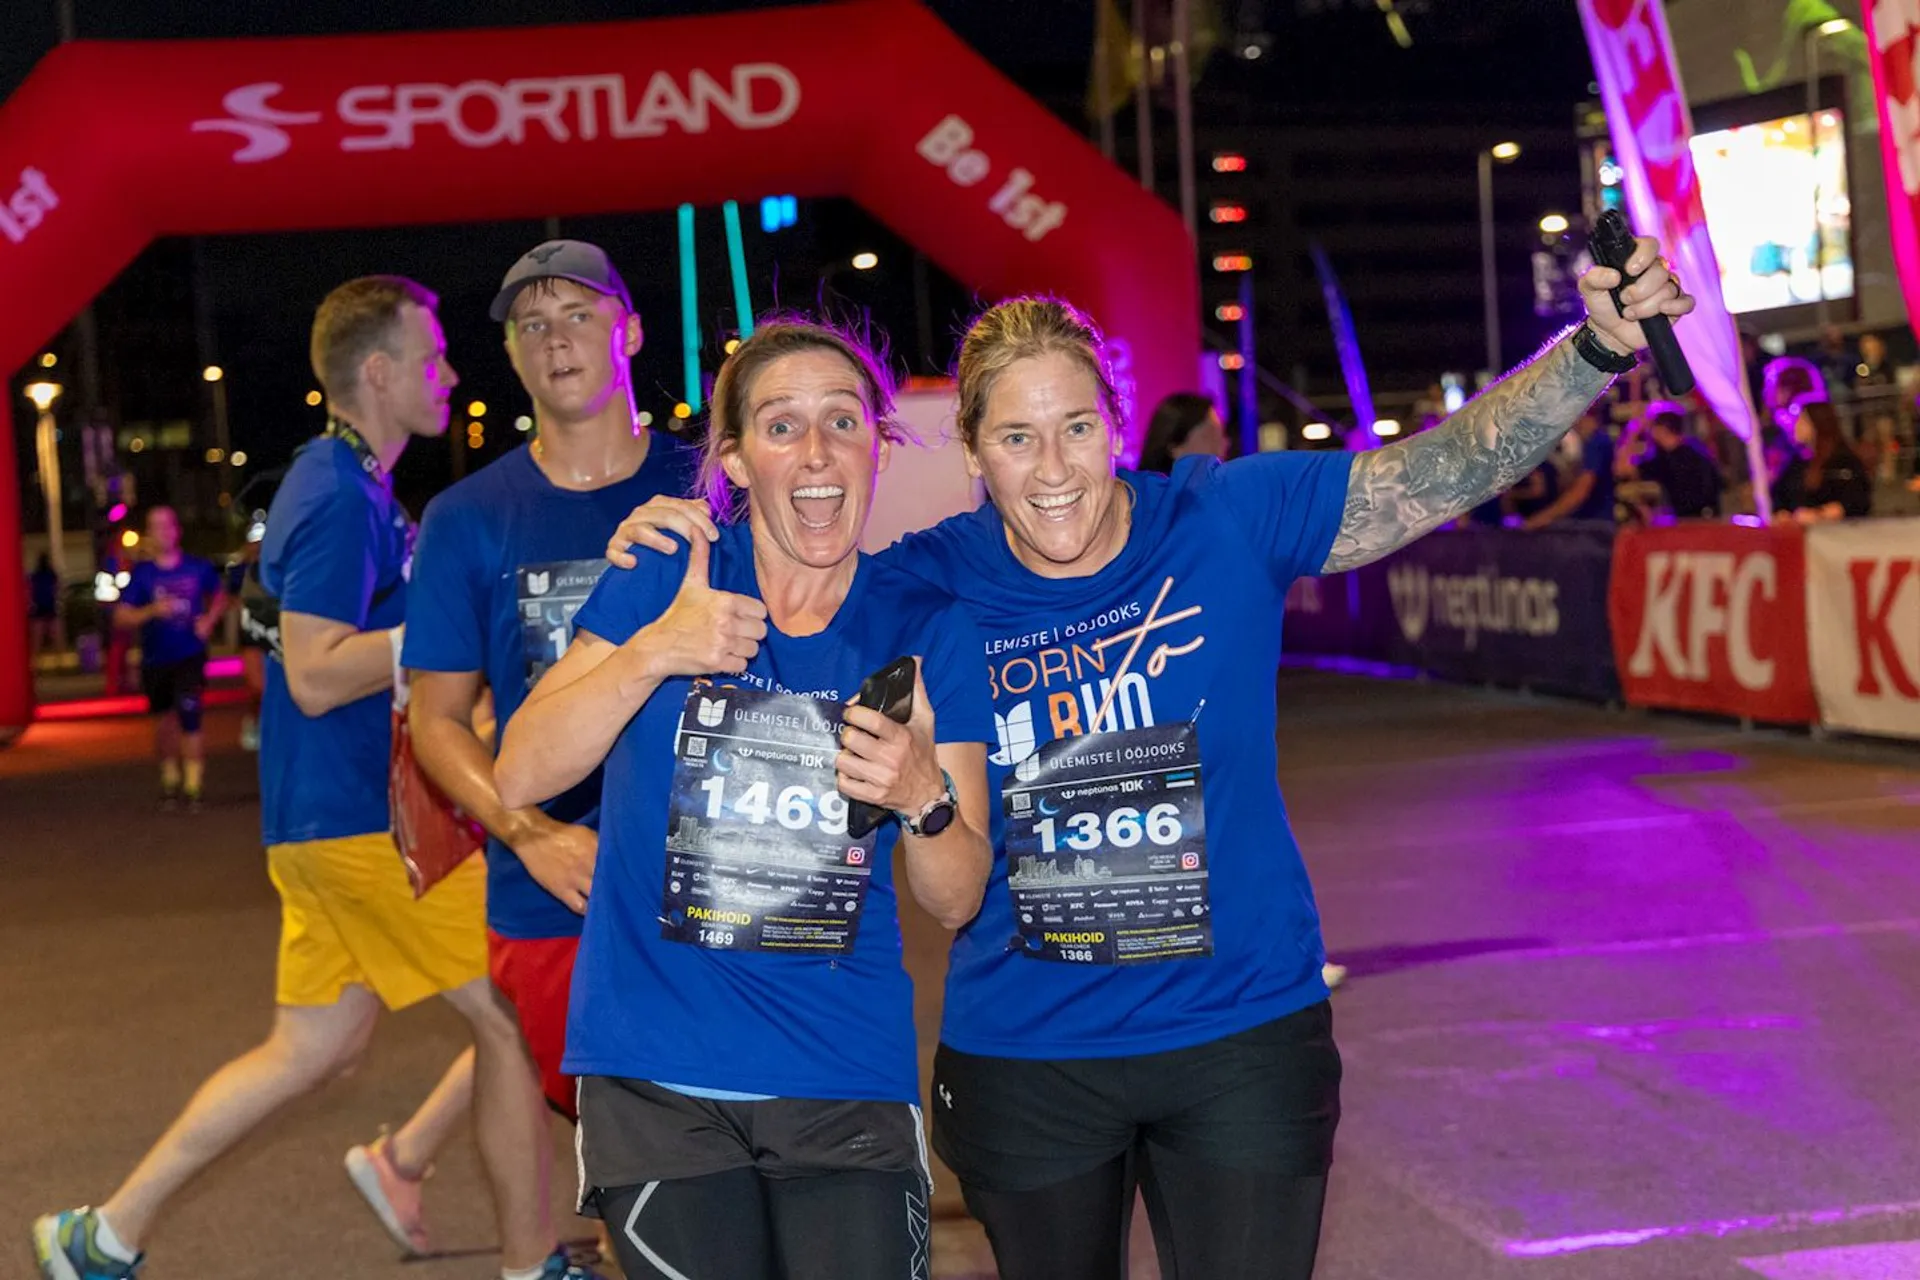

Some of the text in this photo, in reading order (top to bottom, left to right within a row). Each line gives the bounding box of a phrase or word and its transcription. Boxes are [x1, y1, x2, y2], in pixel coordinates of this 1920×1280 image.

[337, 62, 801, 151] SPORTLAND
[915, 113, 1068, 242] Be 1st
[1629, 551, 1776, 691] KFC
[735, 707, 800, 729] ÜLEMISTE
[800, 754, 823, 768] 10K
[1050, 751, 1113, 770] ÜLEMISTE
[1125, 742, 1185, 760] ÖÖJOOKS
[1119, 779, 1144, 793] 10K
[701, 775, 849, 835] 1469
[1032, 803, 1183, 853] 1366
[687, 905, 752, 926] PAKIHOID
[699, 930, 734, 945] 1469
[1044, 932, 1105, 943] PAKIHOID
[1060, 949, 1093, 961] 1366
